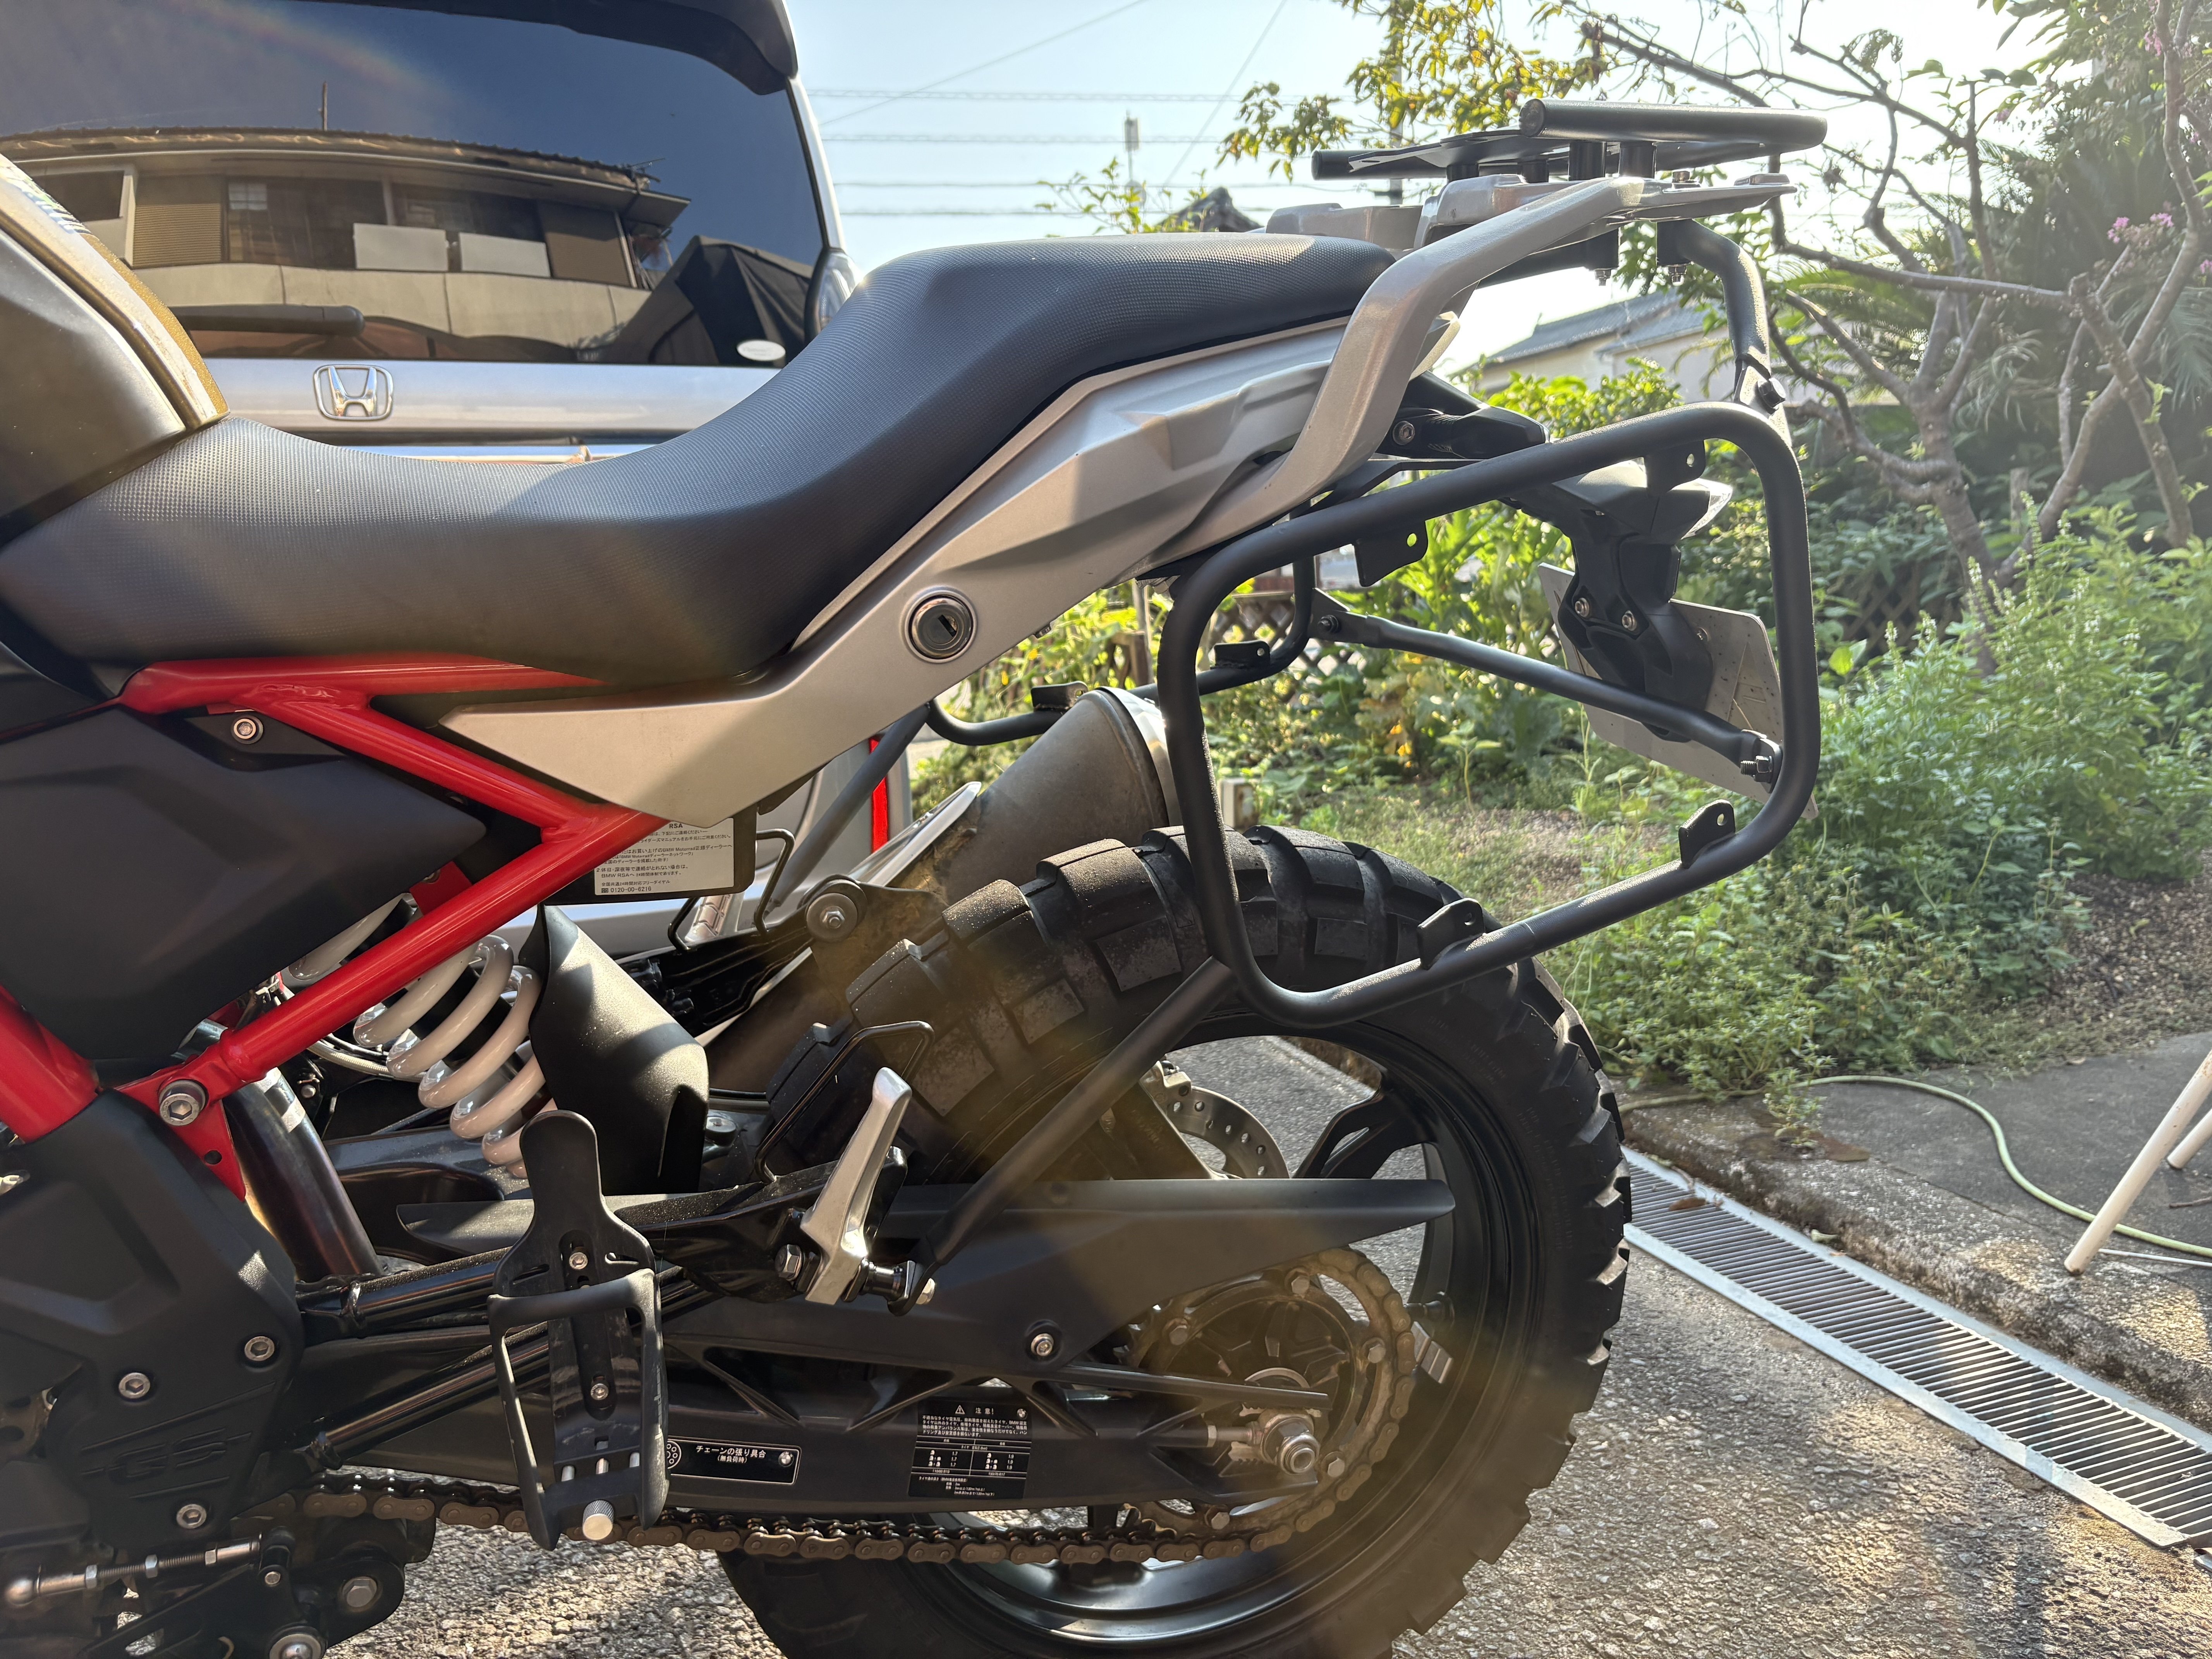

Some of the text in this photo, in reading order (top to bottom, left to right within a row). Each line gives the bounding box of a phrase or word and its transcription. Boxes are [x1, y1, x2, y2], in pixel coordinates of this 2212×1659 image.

[696, 1445, 766, 1458] チェーンの張り具合
